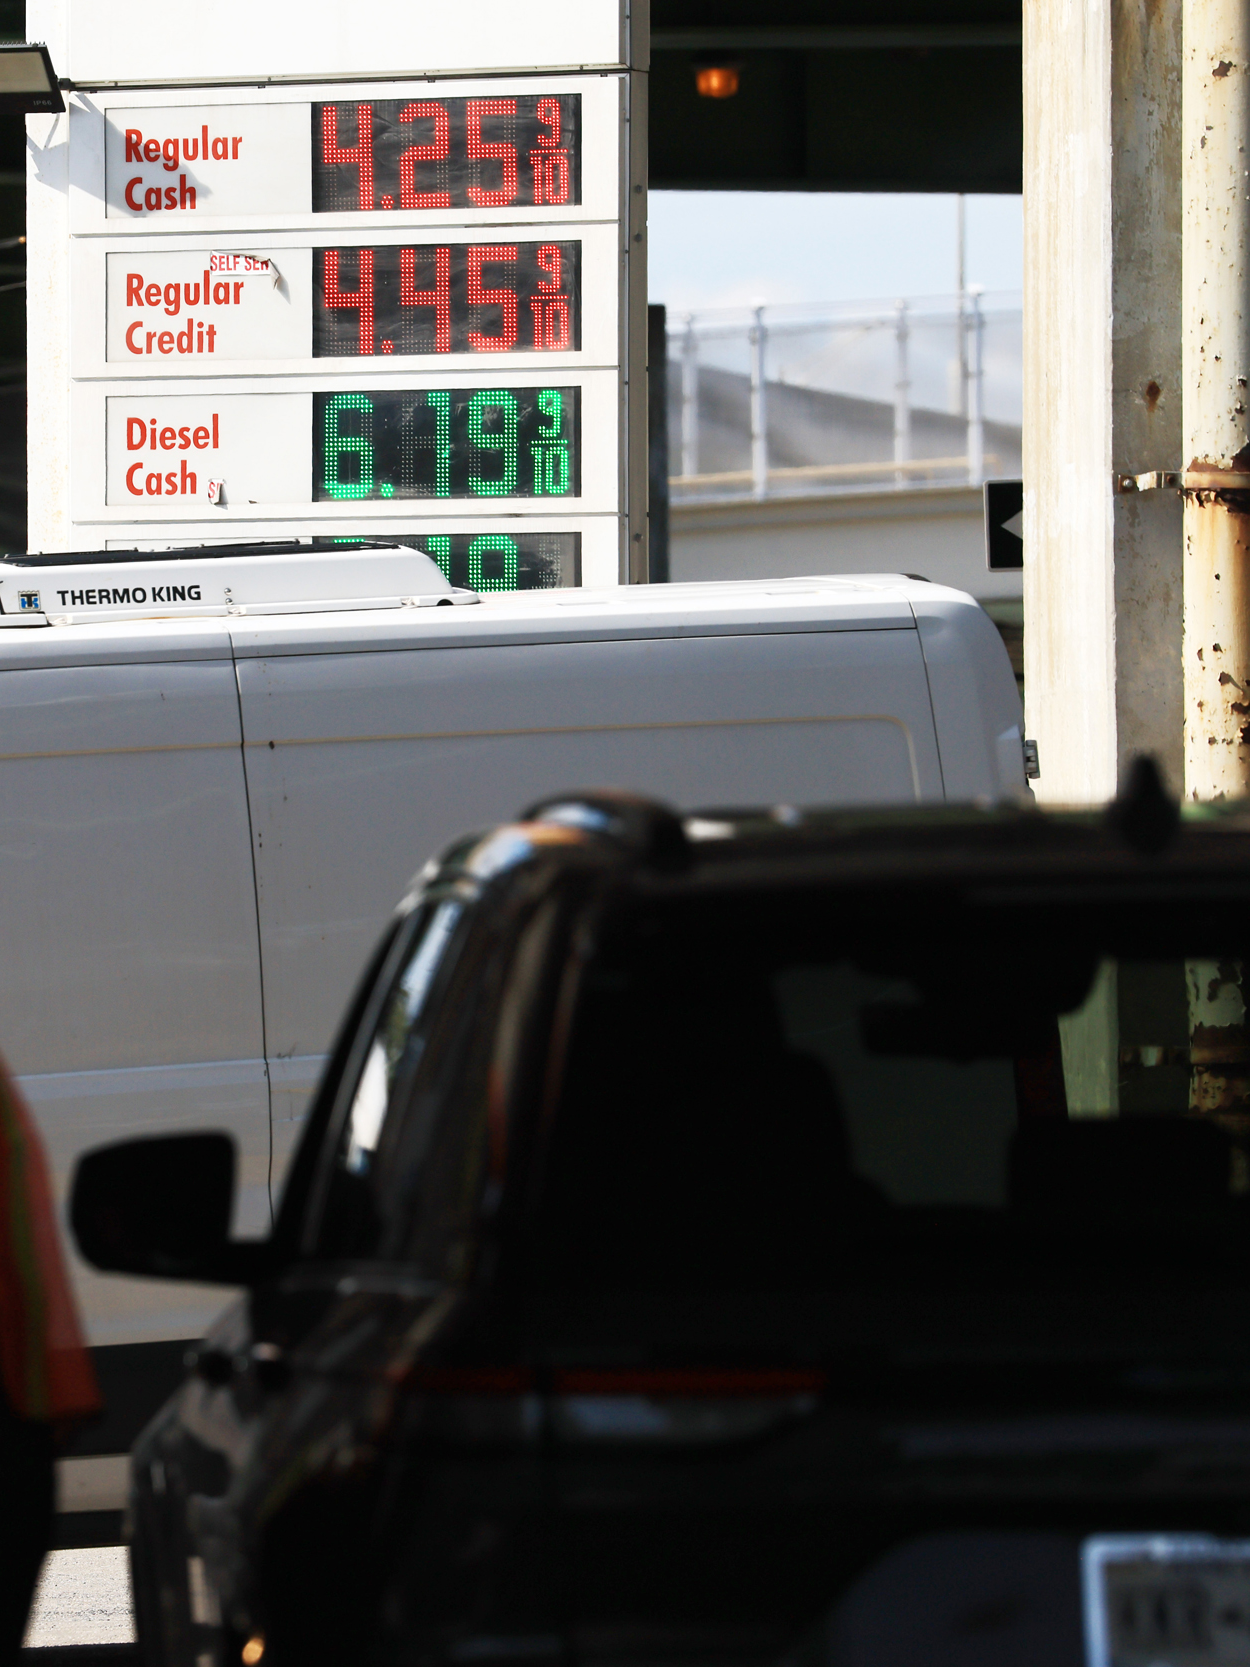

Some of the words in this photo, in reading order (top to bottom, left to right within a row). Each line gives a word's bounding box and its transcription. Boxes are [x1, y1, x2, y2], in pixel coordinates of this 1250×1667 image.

[125, 125, 243, 171] Regular
[323, 101, 517, 210] 4.25
[125, 174, 196, 211] Cash
[210, 255, 241, 271] SELF
[126, 270, 244, 316] Regular
[324, 247, 517, 355] 4.45
[125, 318, 217, 354] Credit
[126, 413, 219, 450] Diesel
[325, 390, 517, 498] 6.19
[125, 460, 197, 496] Cash
[57, 587, 147, 606] THERMO
[152, 585, 201, 603] KING
